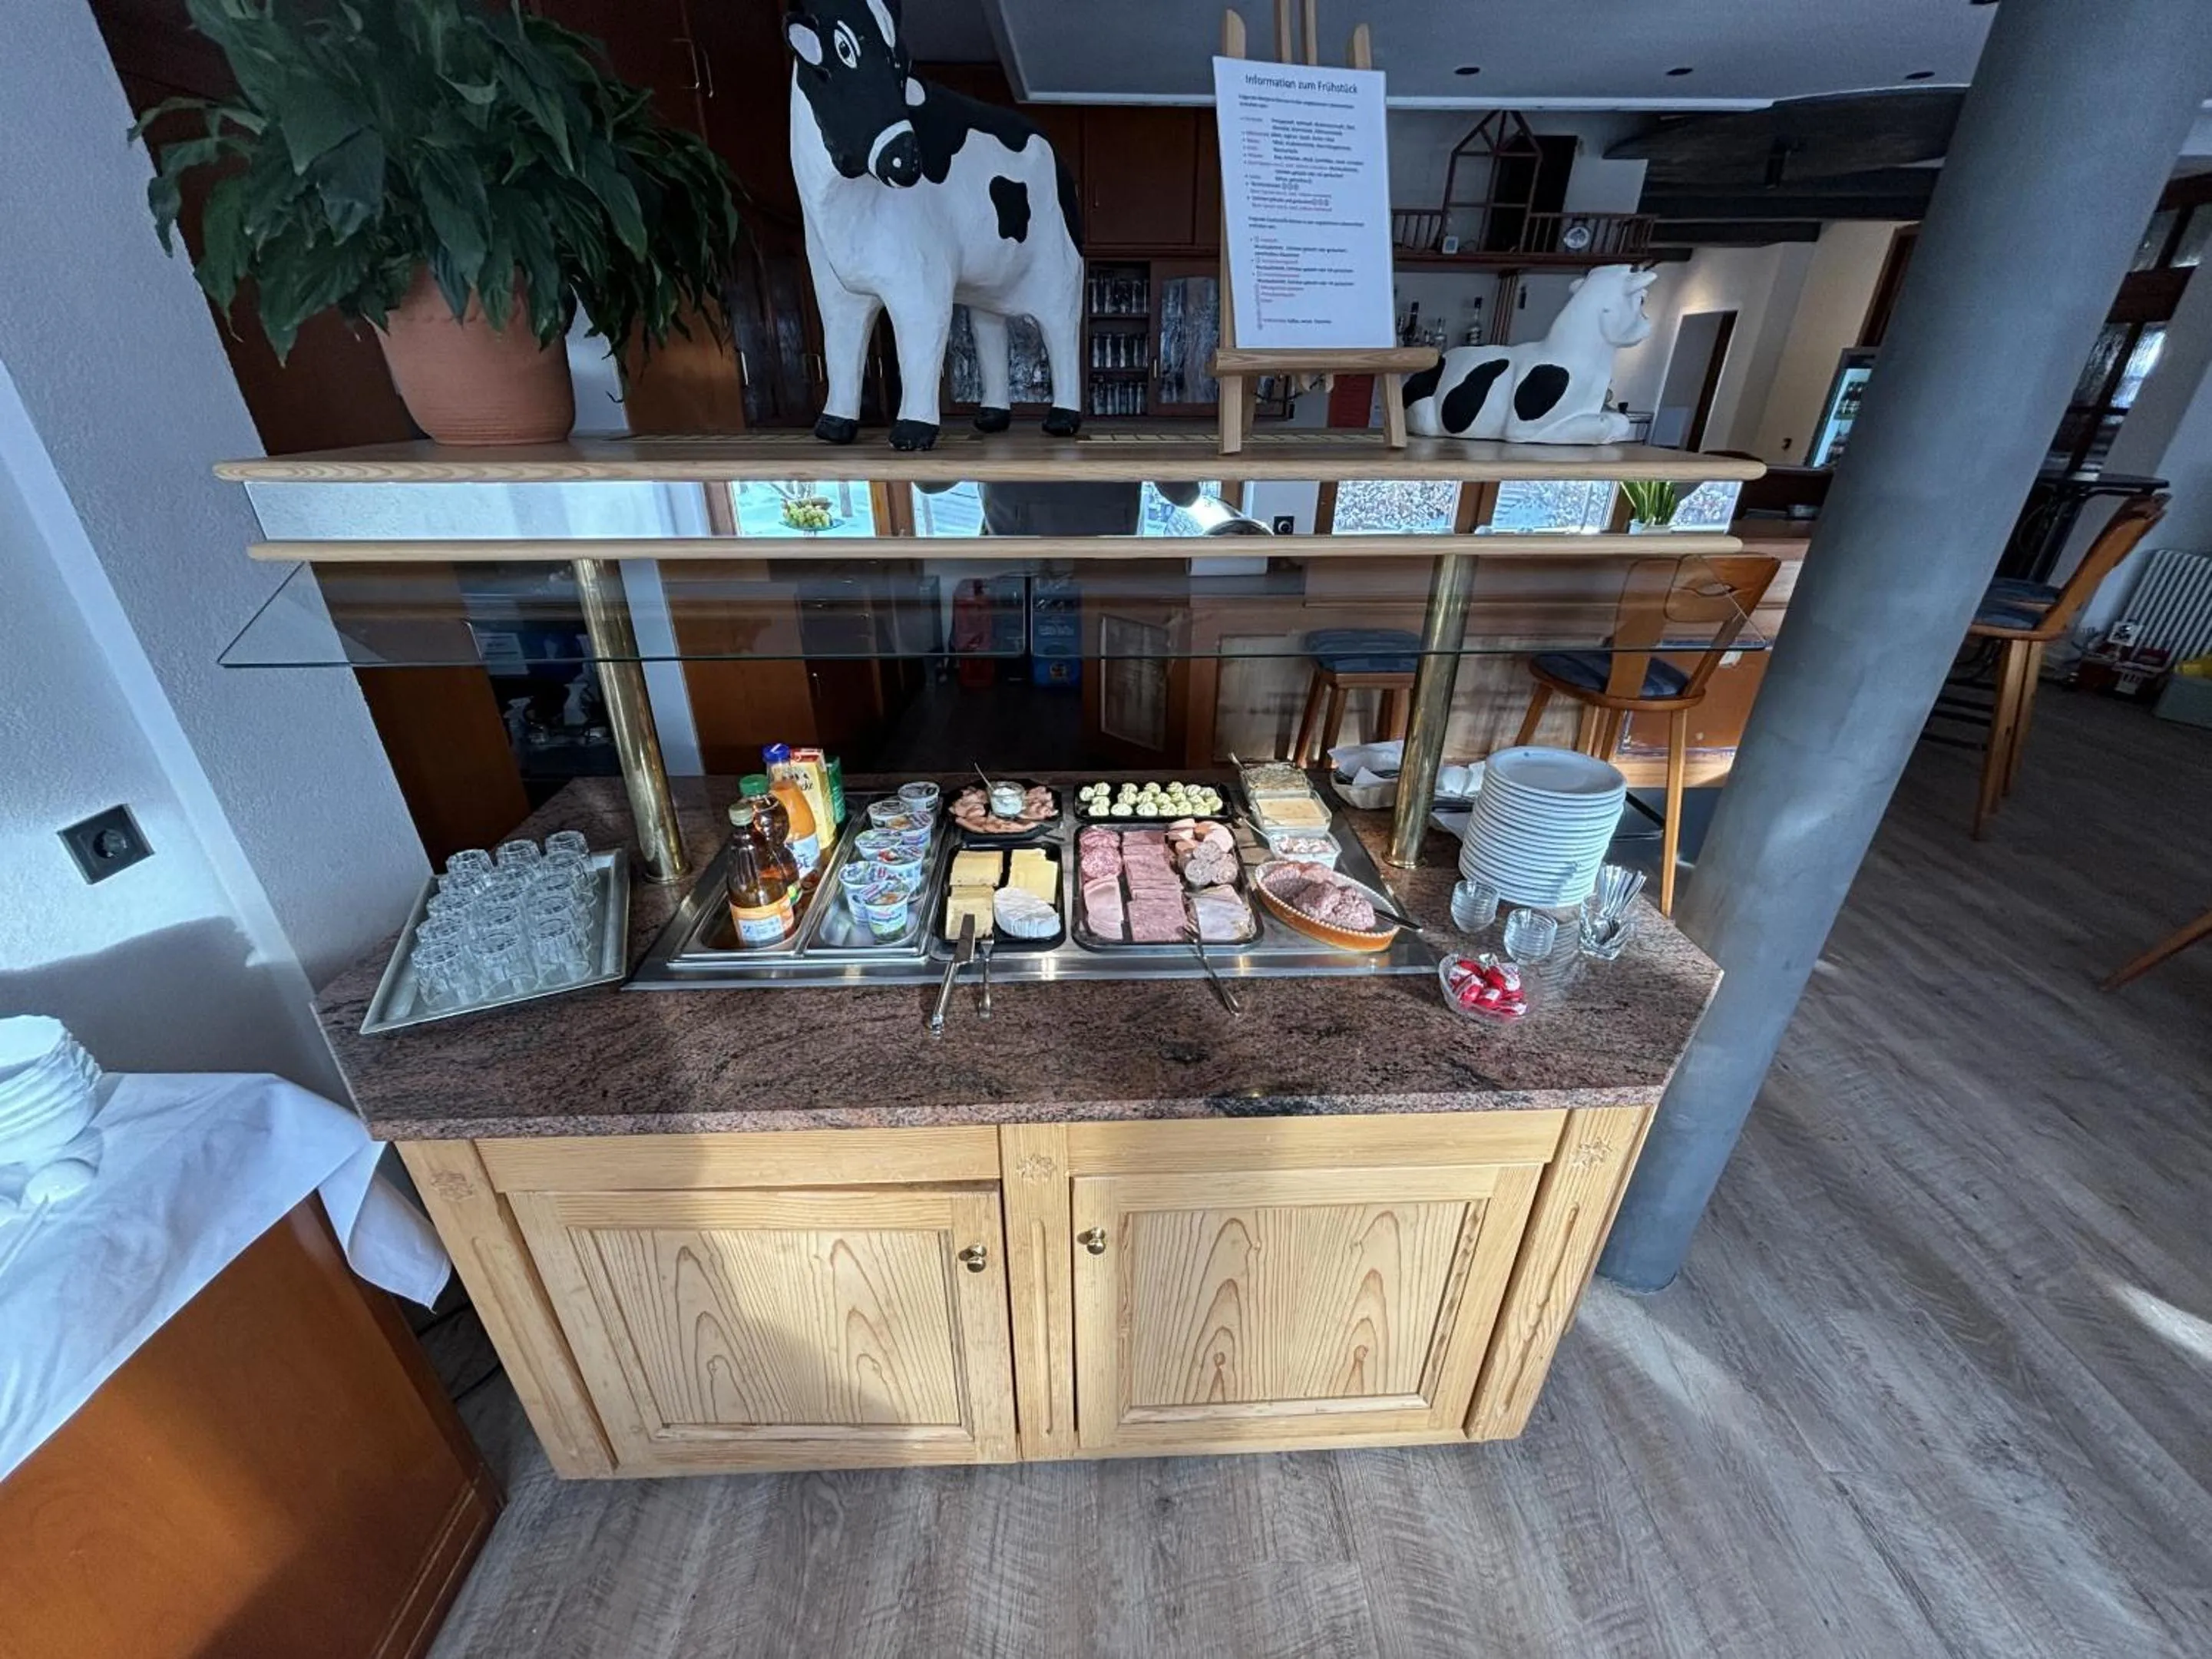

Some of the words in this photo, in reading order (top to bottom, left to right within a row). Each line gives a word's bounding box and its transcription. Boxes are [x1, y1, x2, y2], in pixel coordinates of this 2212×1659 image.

[1245, 74, 1296, 89] Information
[1298, 80, 1316, 90] zum
[1318, 79, 1357, 93] Frühstück
